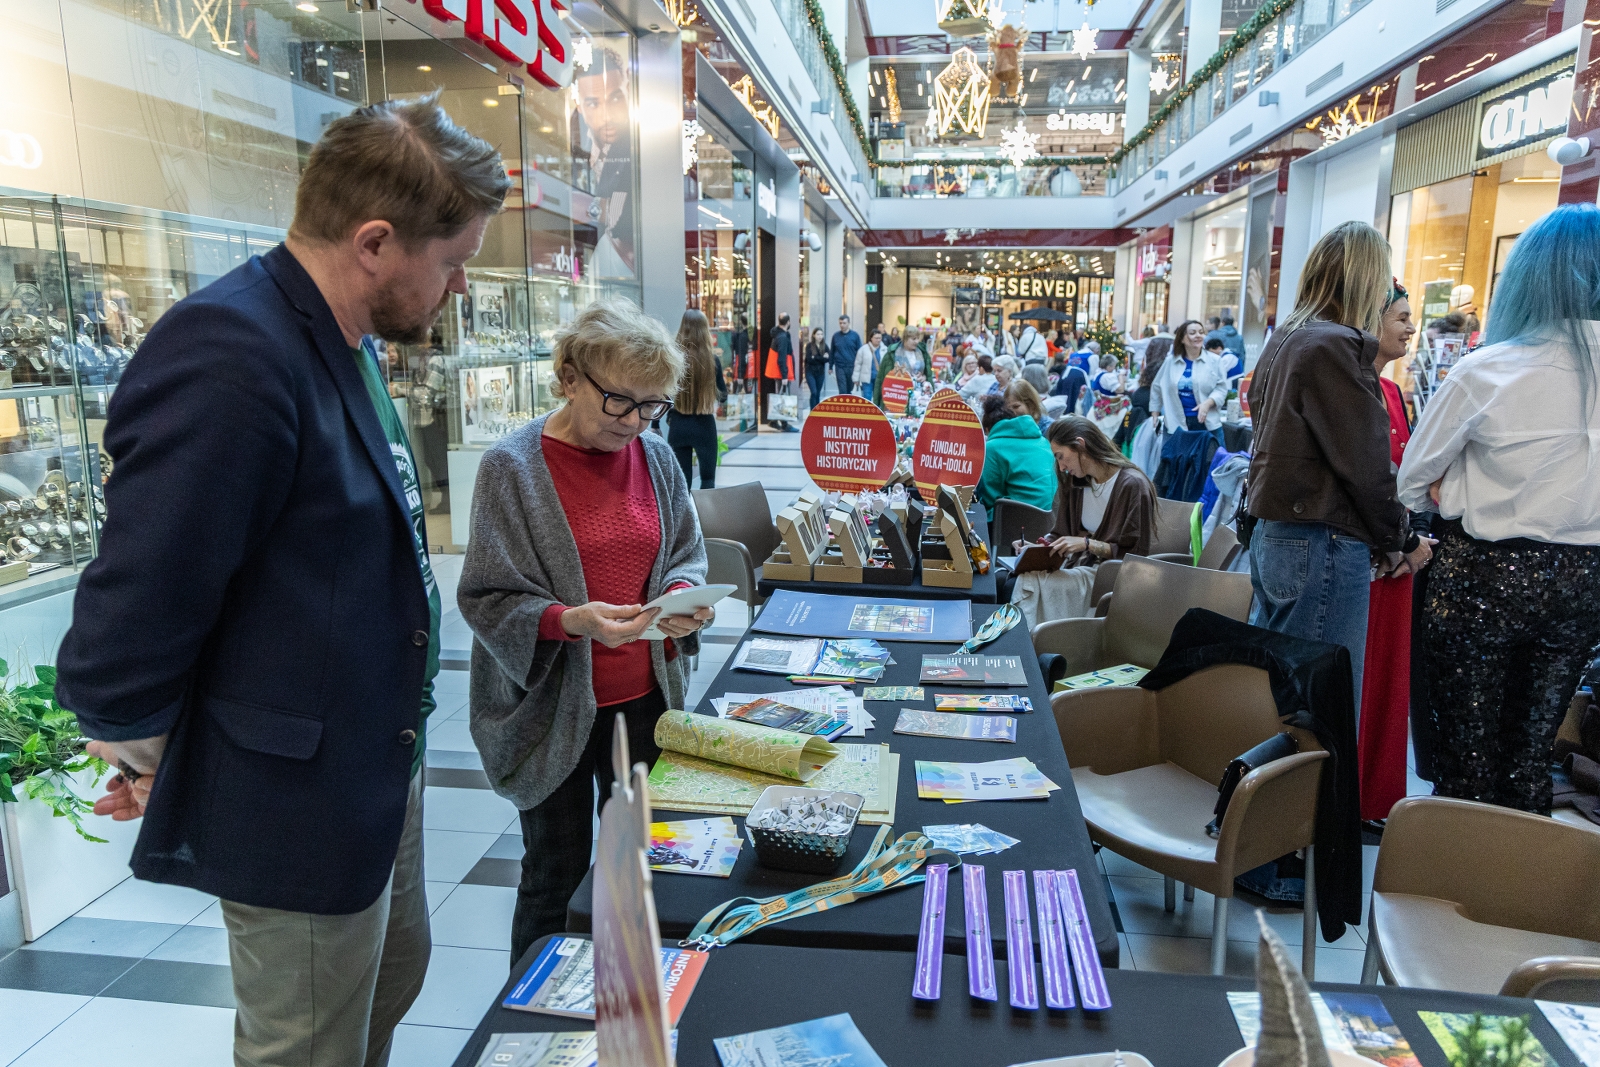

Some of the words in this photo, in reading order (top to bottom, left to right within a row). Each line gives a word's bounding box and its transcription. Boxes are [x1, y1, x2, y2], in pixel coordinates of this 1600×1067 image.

[1046, 108, 1116, 136] sinsay
[823, 425, 872, 441] MILITARNY
[825, 441, 870, 456] INSTYTUT
[930, 439, 967, 457] FUNDACJA
[816, 455, 878, 472] HISTORYCZNY
[920, 454, 973, 475] POLKA-IDOLKA
